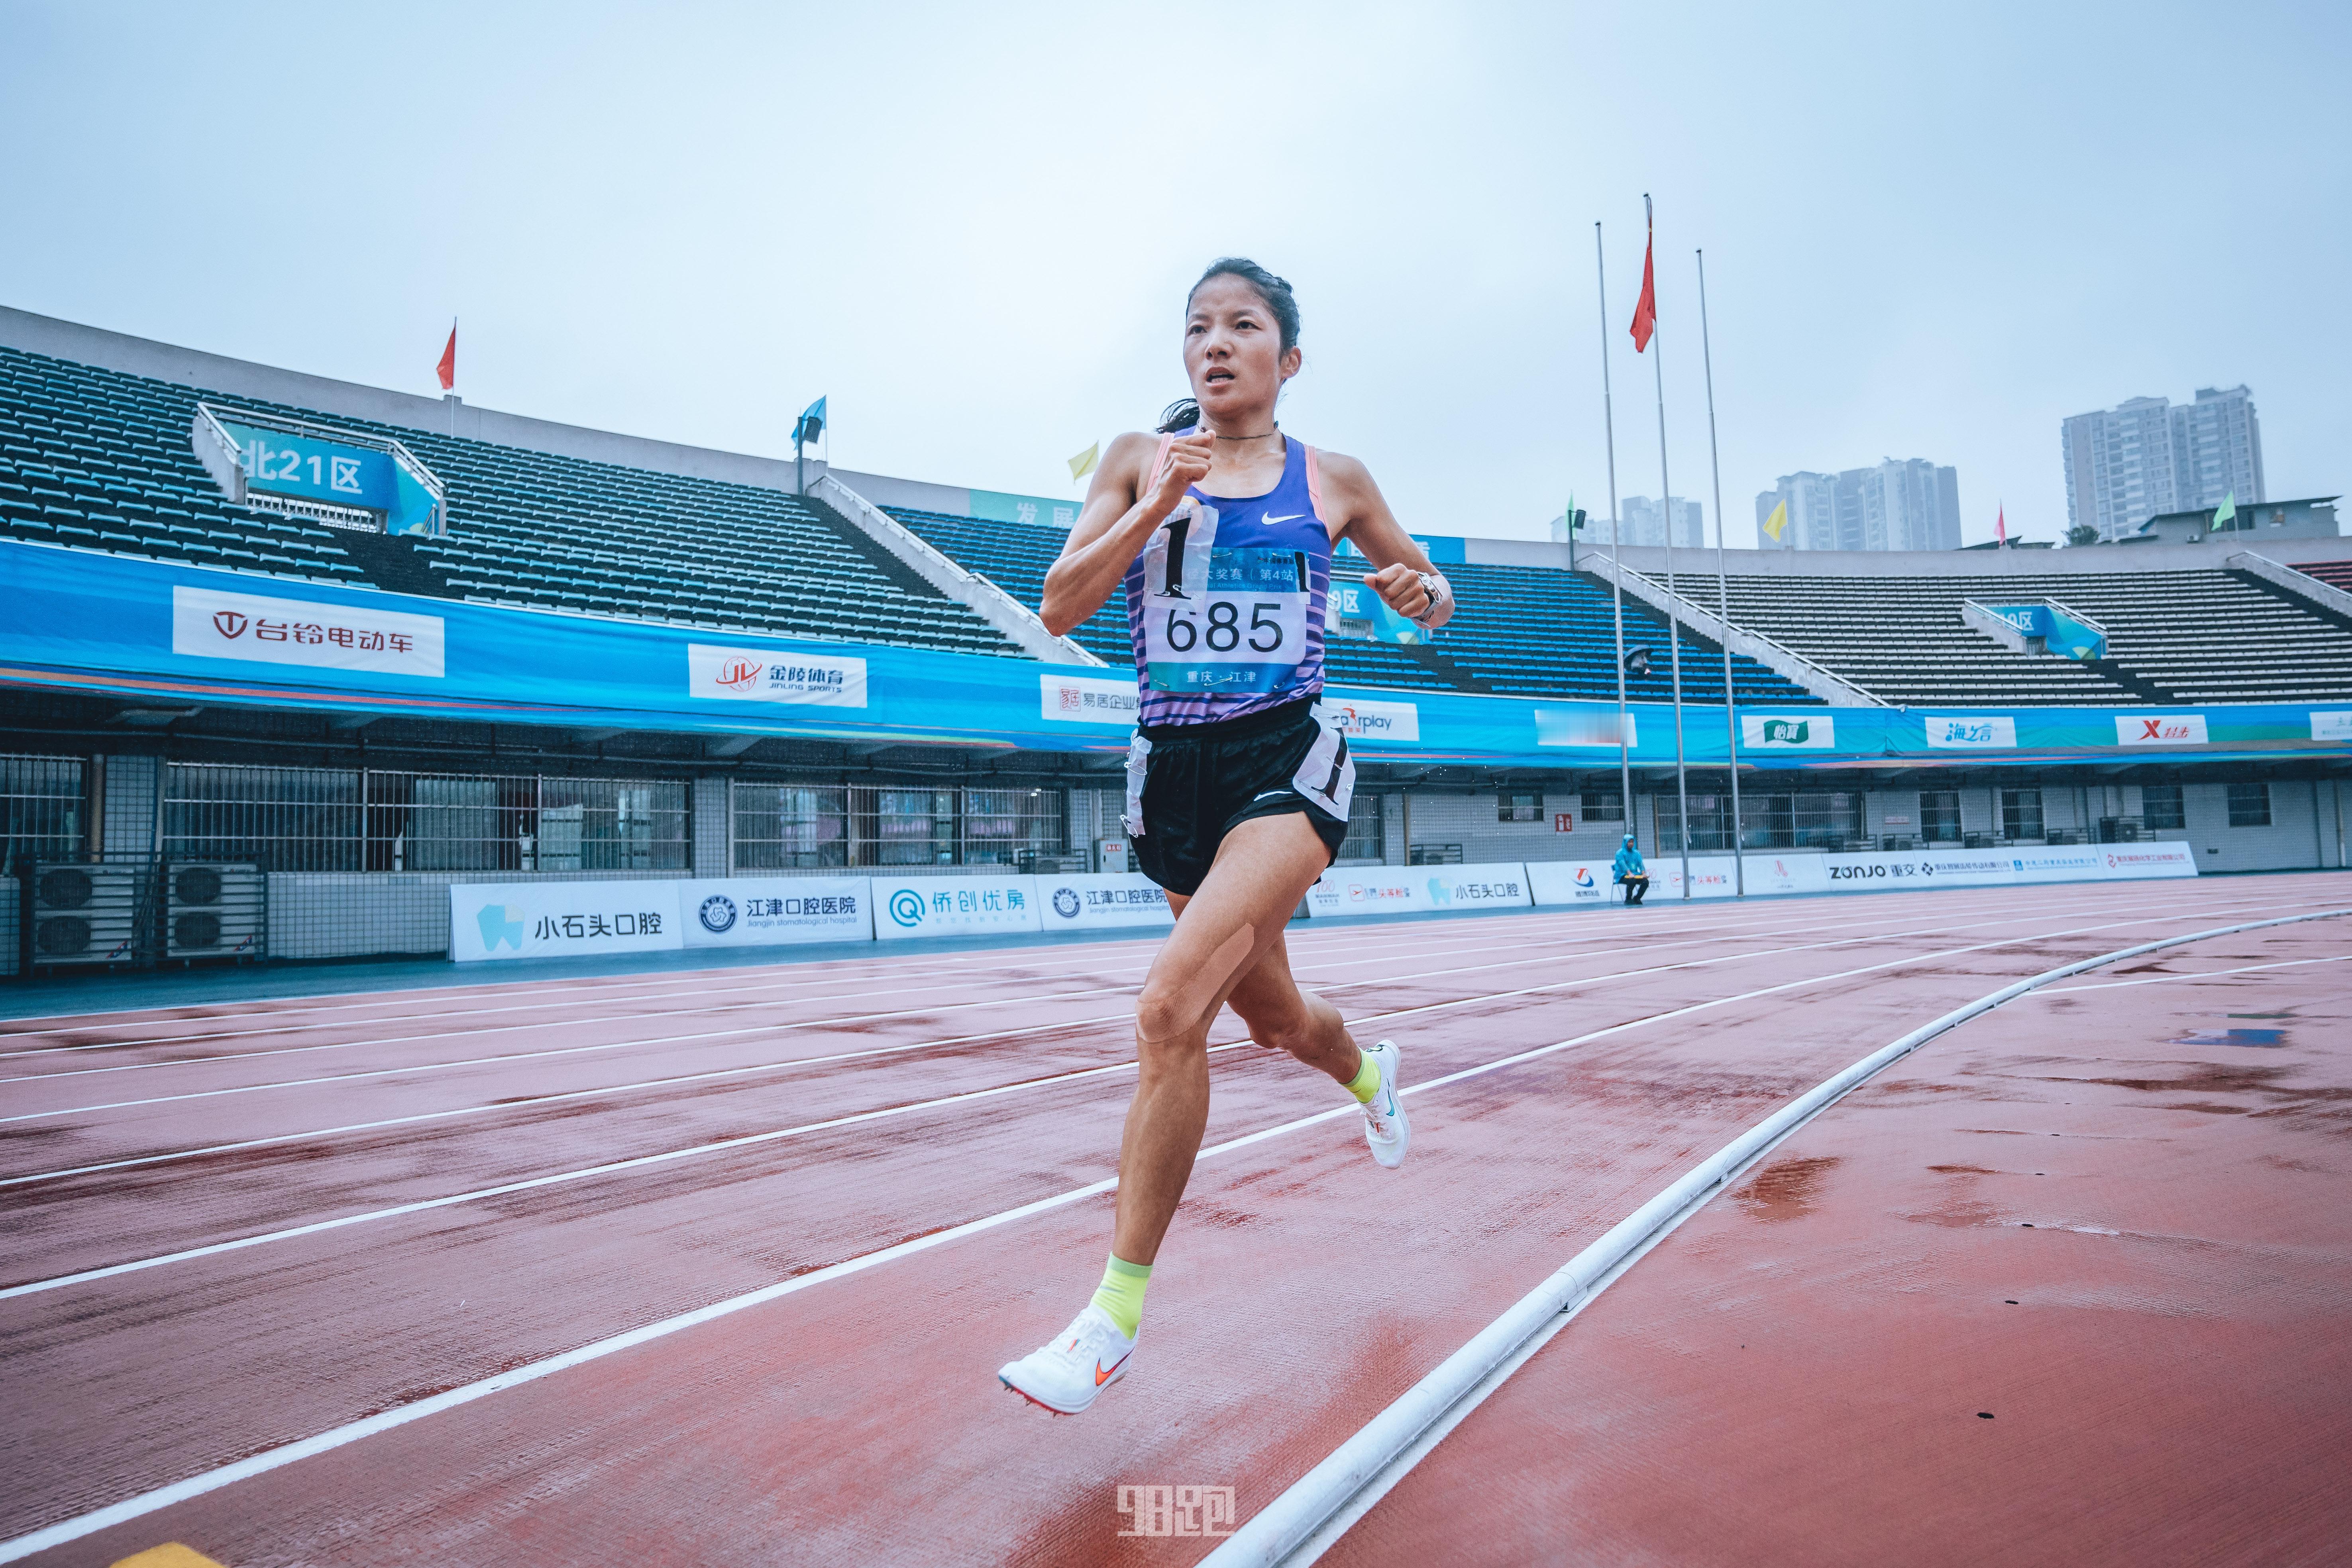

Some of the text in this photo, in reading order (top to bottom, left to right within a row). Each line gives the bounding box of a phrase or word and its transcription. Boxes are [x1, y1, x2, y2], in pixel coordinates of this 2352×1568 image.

[240, 440, 362, 494] 北21区
[1154, 518, 1191, 600] 1
[256, 619, 413, 653] 台铃电动车
[1166, 601, 1283, 653] 685
[769, 665, 843, 685] 金陵体育
[1084, 693, 1141, 710] 易居企业
[933, 889, 1025, 913] 侨创优房
[1456, 883, 1519, 899] 小石头口腔
[747, 896, 856, 916] 江津口腔医院
[535, 912, 662, 940] 小石头口腔
[830, 916, 857, 925] hospital
